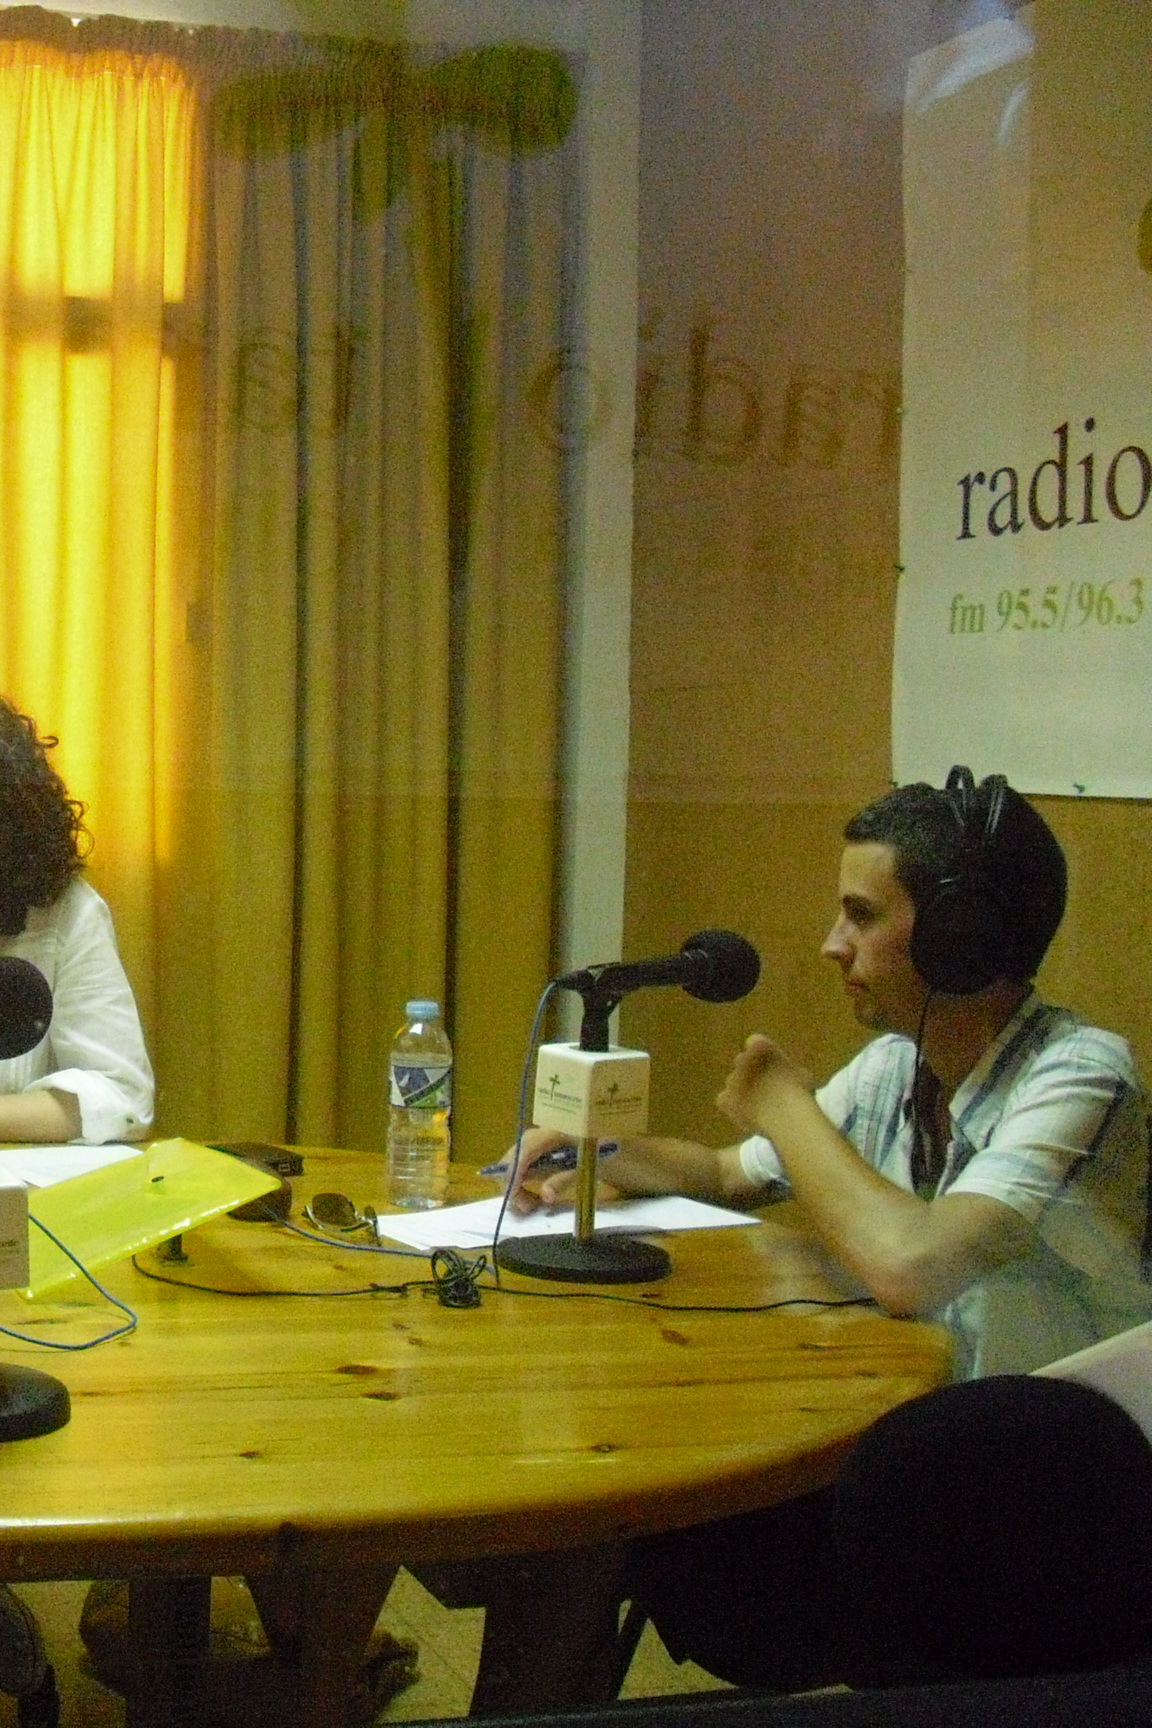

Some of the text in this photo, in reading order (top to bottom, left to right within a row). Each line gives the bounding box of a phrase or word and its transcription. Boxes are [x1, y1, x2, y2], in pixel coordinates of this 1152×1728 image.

[956, 416, 1152, 541] radio
[950, 577, 1145, 635] fm 95.5/96.3
